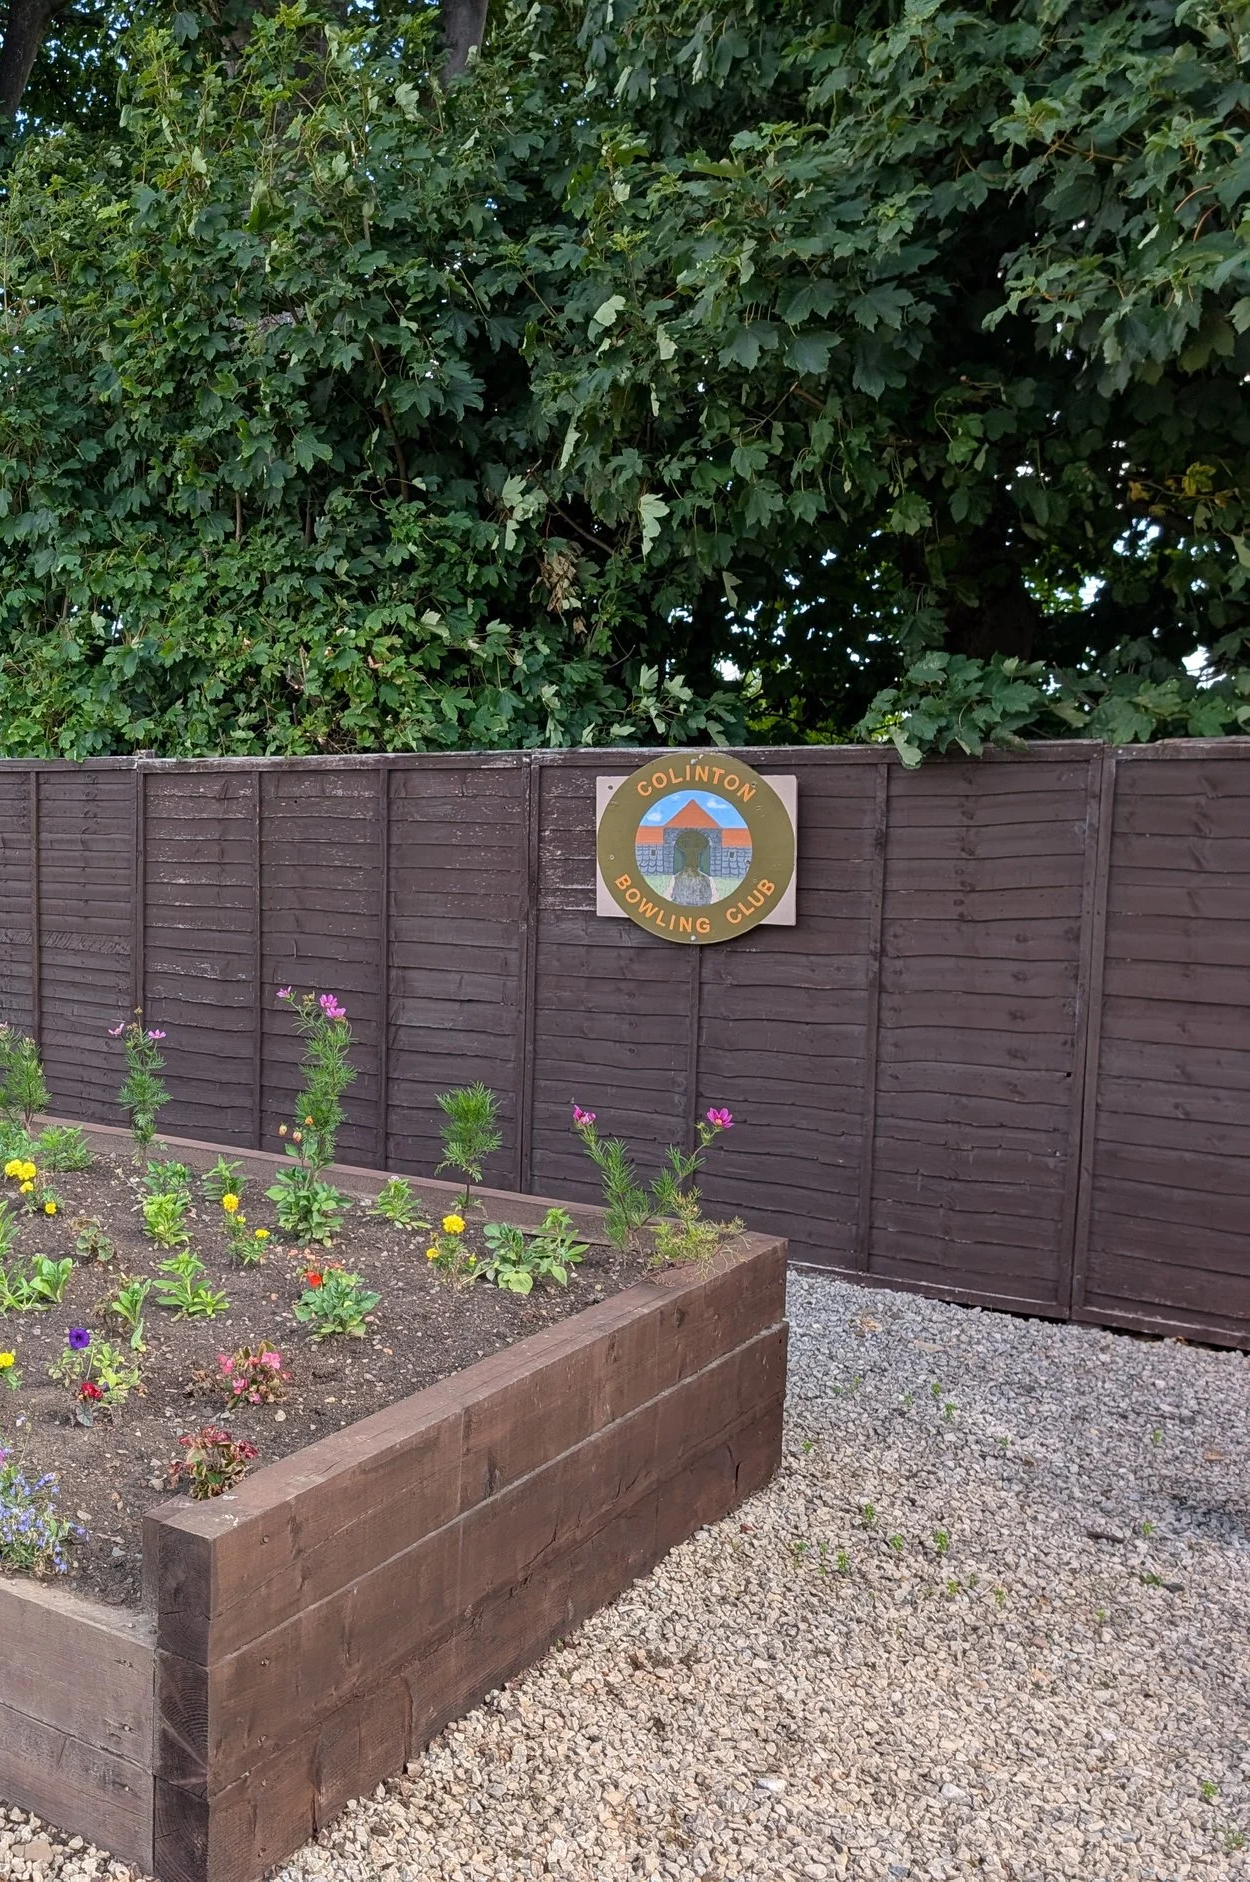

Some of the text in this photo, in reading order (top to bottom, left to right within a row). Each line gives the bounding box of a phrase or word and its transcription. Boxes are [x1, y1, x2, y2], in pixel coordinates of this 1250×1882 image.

[637, 765, 756, 802] COLINTON
[615, 873, 776, 933] BOWLING CLUB
